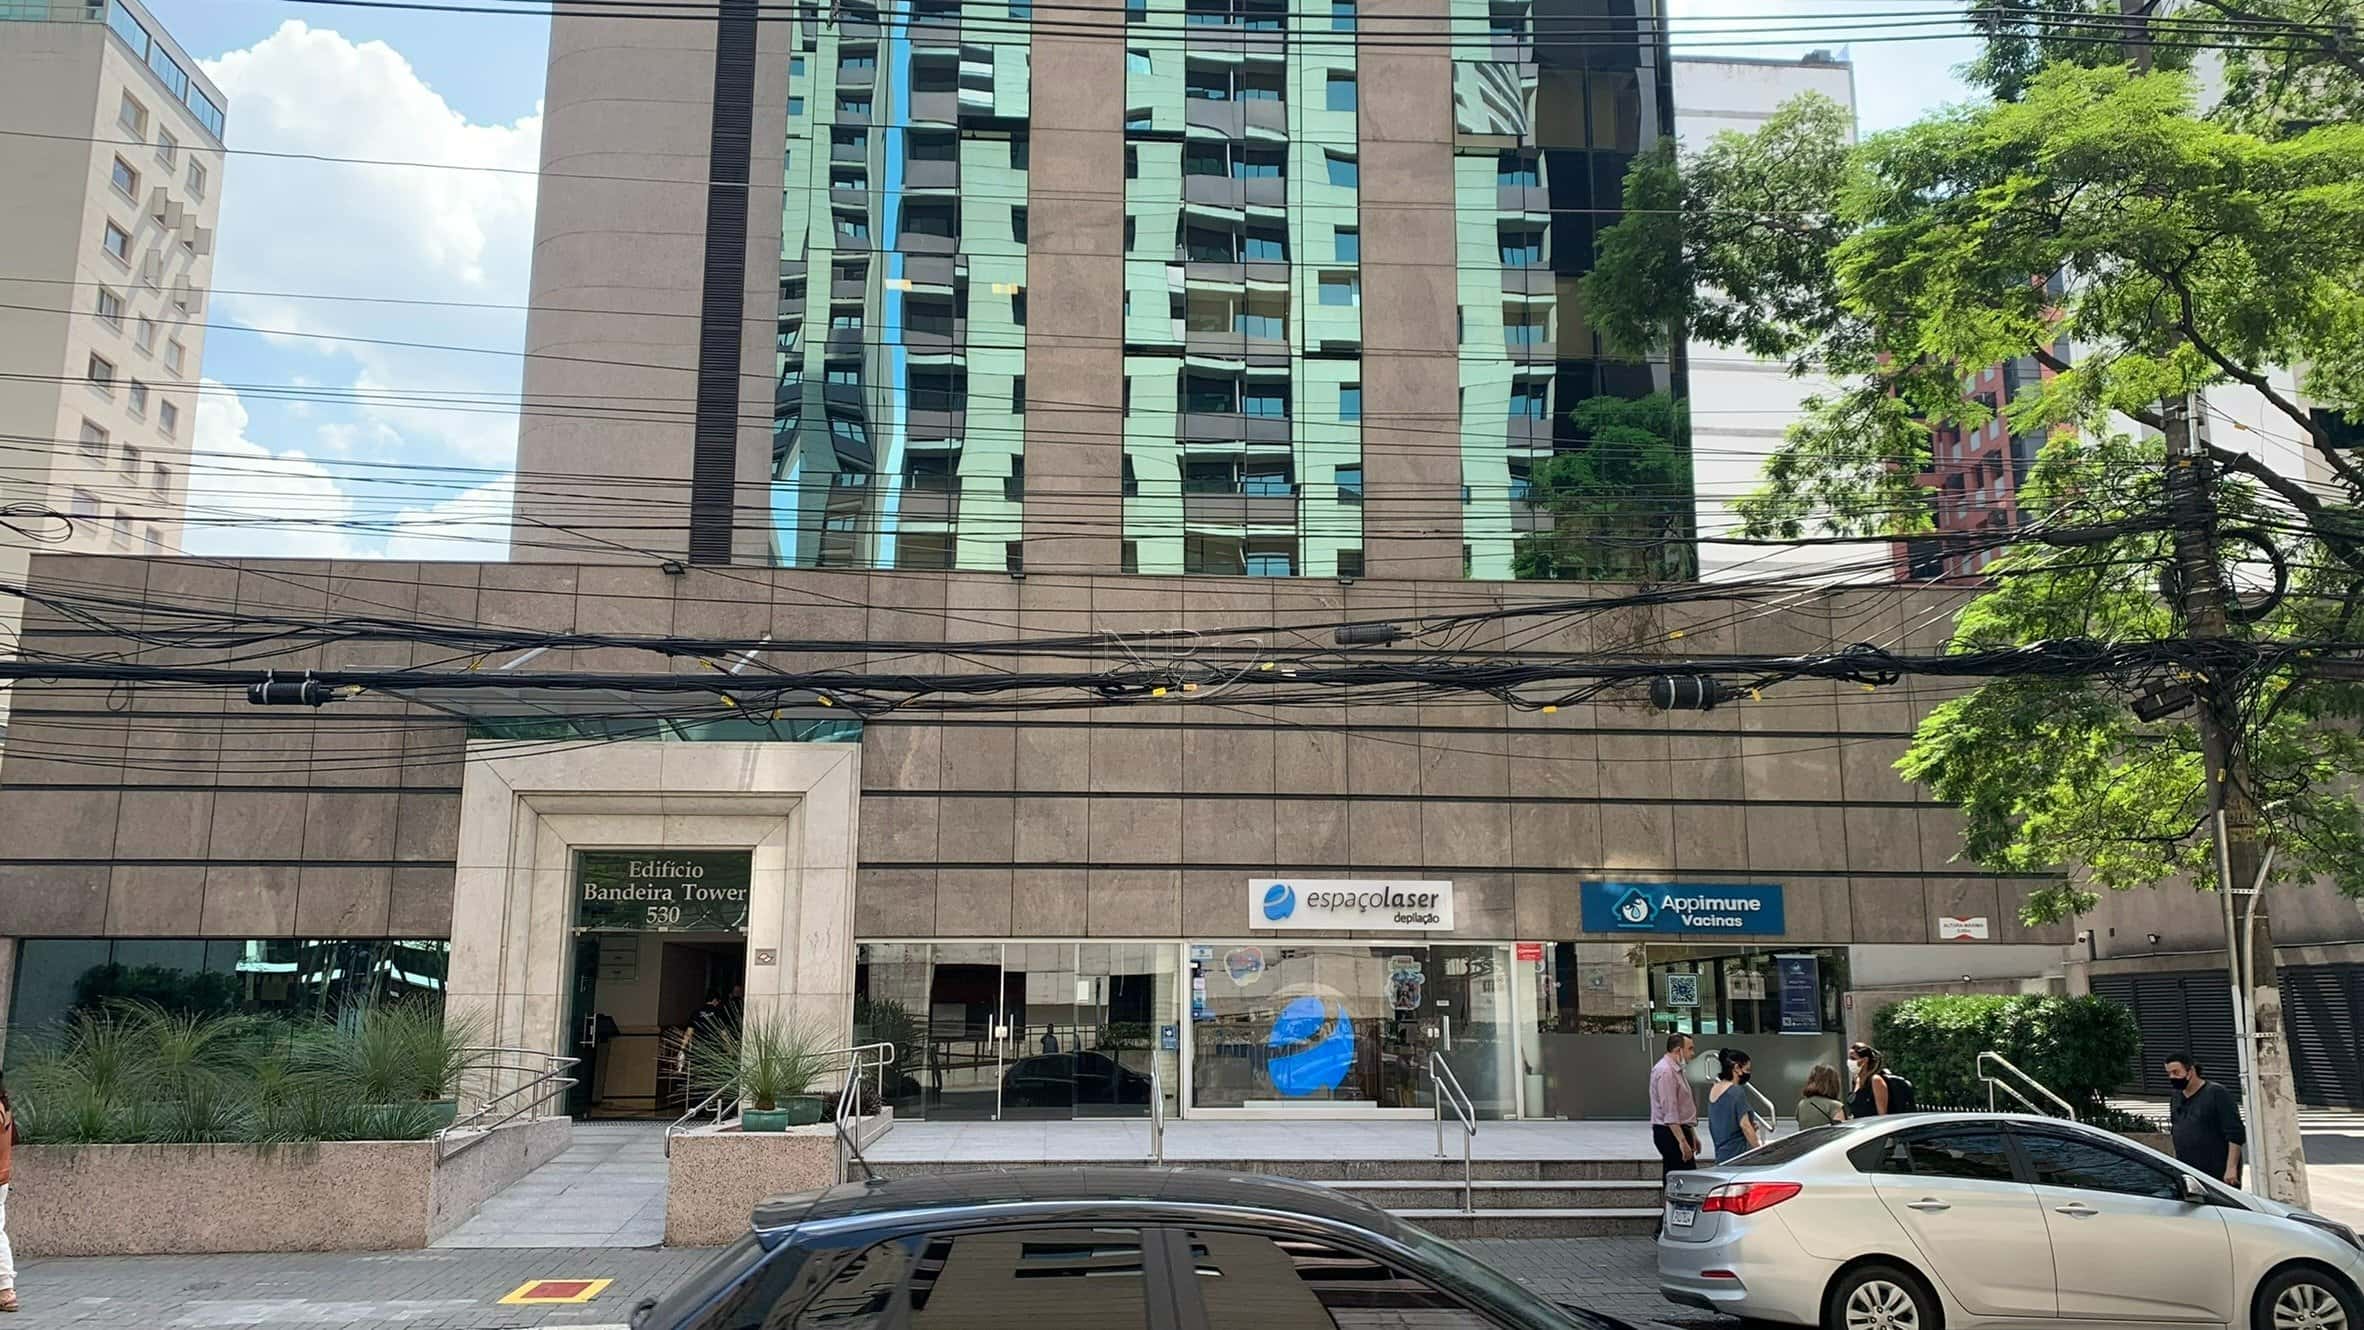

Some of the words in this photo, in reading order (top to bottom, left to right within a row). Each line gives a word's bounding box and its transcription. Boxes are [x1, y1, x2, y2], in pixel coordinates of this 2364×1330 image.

[629, 860, 704, 878] Edifício
[584, 883, 673, 901] Bandeira
[681, 883, 747, 901] Tower
[1306, 886, 1440, 913] espaçolaser
[1660, 894, 1761, 914] Appimune
[646, 907, 681, 924] 530
[1393, 911, 1440, 925] depilação
[1681, 914, 1743, 927] Vacinas
